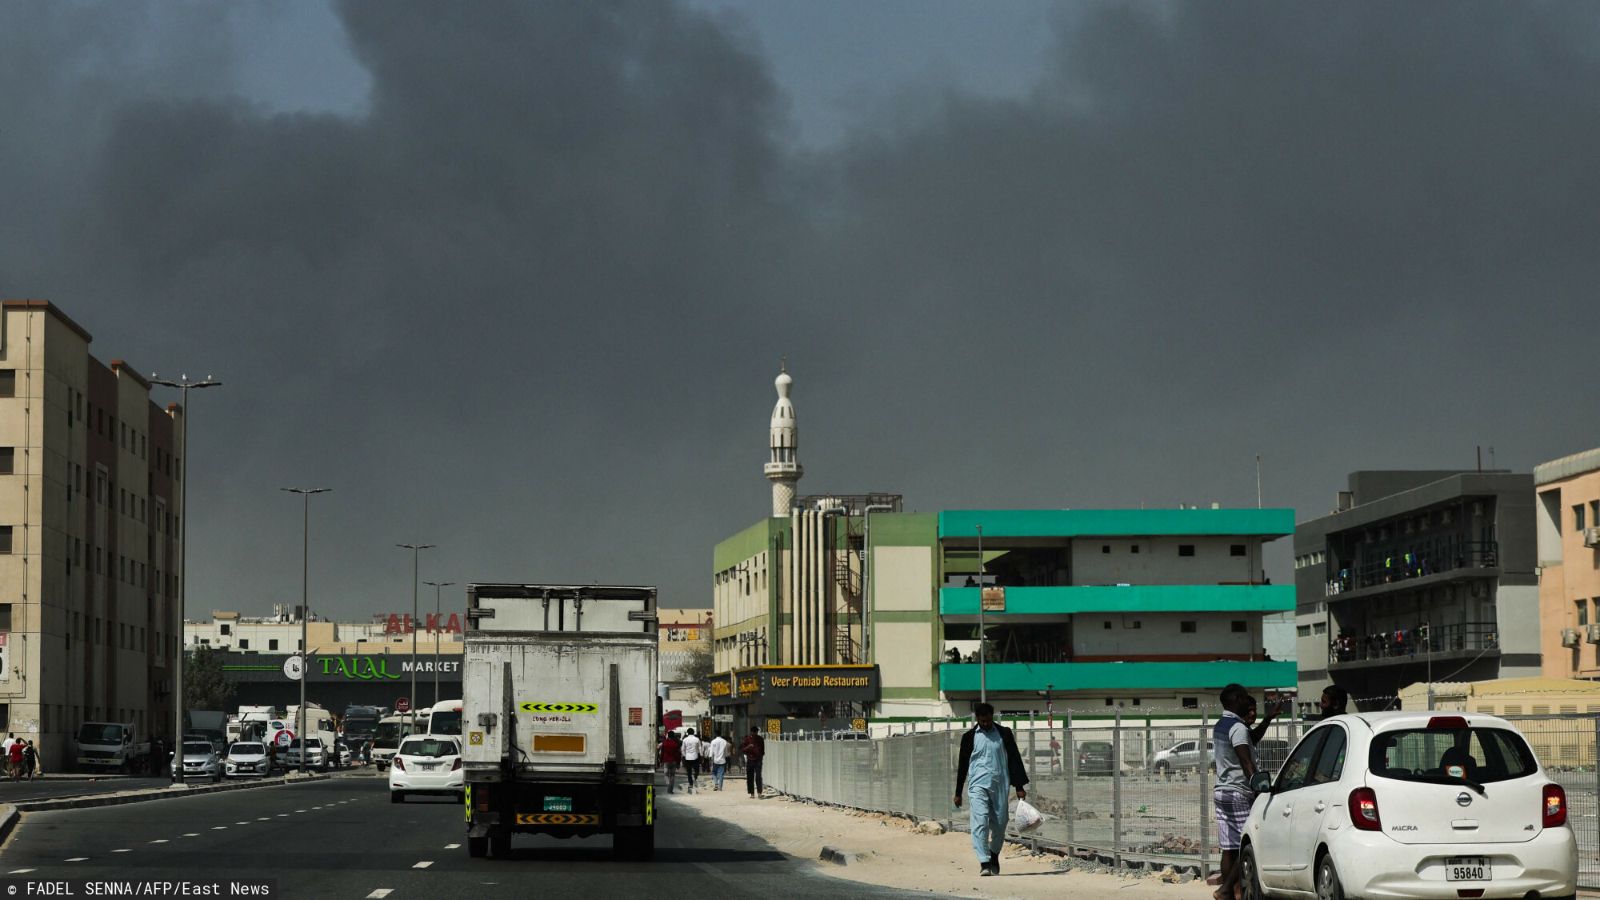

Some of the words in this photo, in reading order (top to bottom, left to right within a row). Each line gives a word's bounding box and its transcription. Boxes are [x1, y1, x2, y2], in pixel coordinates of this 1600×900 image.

[426, 613, 467, 633] KA
[317, 656, 401, 680] TALAL
[402, 661, 459, 672] MARKET
[771, 676, 790, 687] Veer
[792, 676, 821, 687] Punjab
[823, 676, 869, 687] Restaurant
[1453, 867, 1484, 879] 95840
